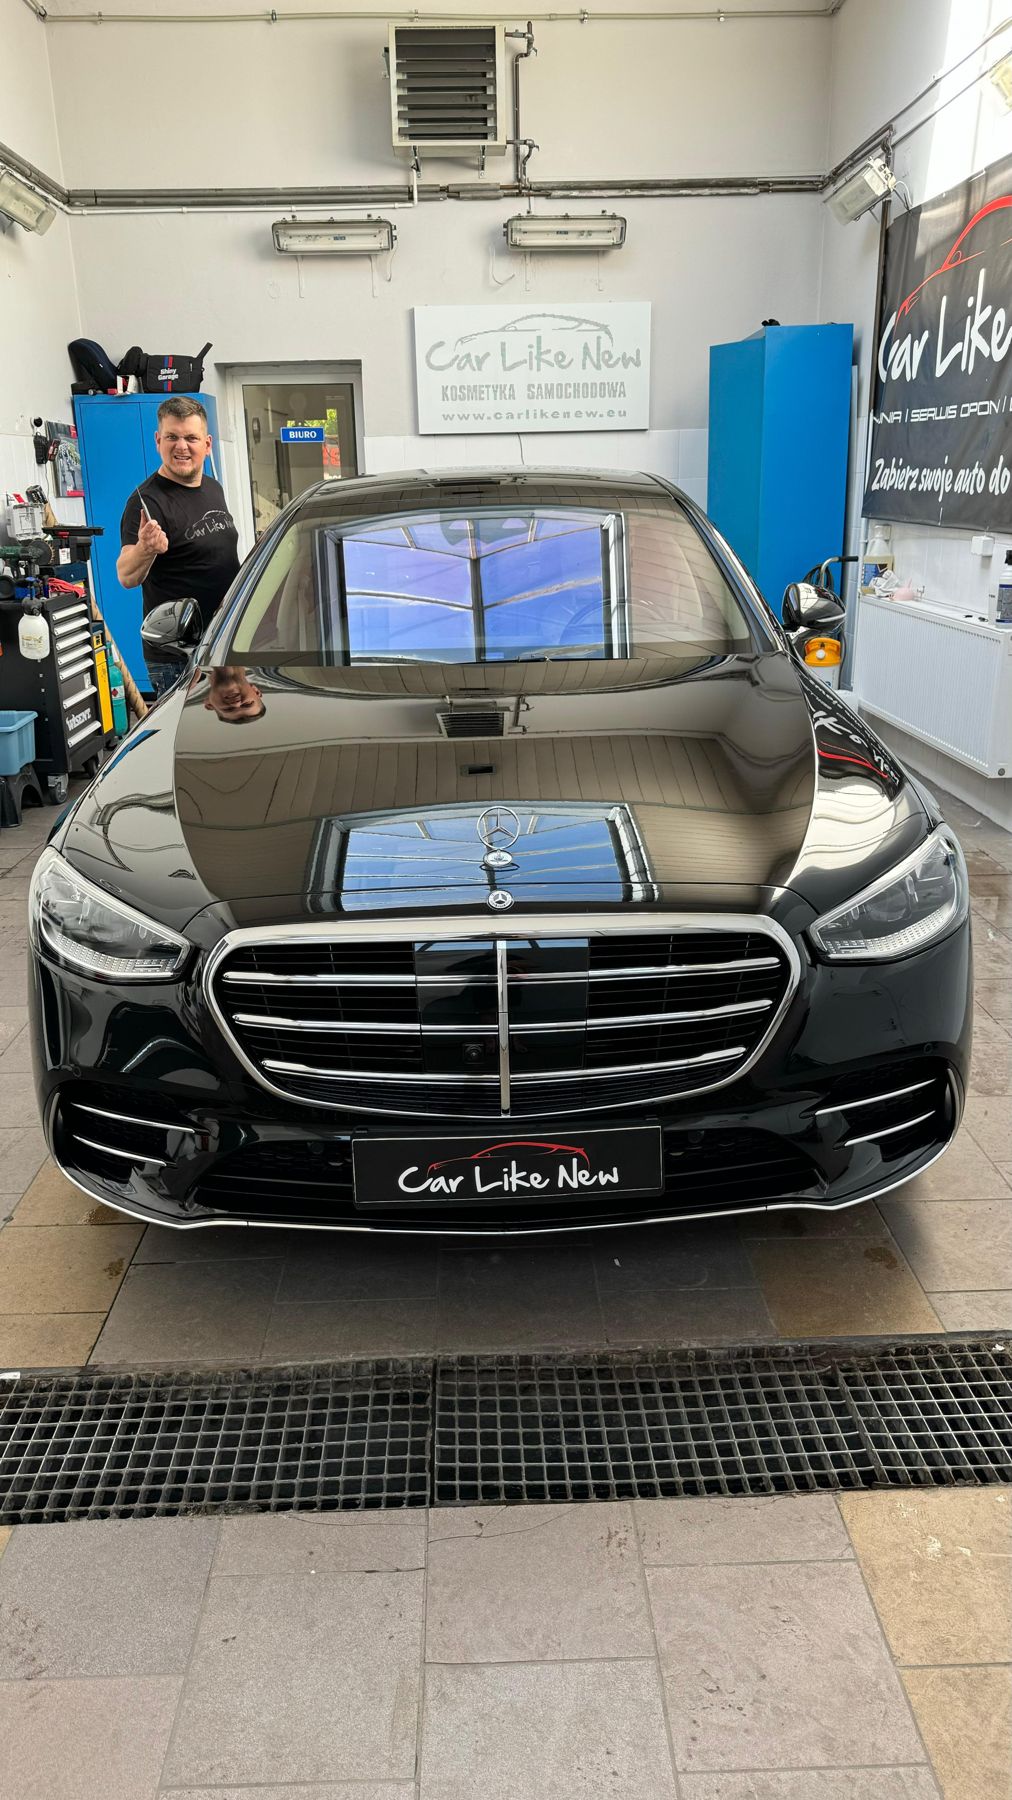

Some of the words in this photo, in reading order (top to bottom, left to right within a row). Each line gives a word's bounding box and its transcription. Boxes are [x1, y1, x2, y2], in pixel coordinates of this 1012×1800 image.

[878, 311, 929, 383] Car
[935, 268, 1012, 377] Like
[425, 340, 491, 371] Car
[500, 335, 574, 372] Like
[582, 335, 642, 371] New
[441, 383, 516, 402] KOSMETYKA
[527, 381, 627, 400] SAMOCHODOWA
[442, 408, 627, 421] www.carlikenew.eu
[910, 405, 958, 422] SERWIS
[960, 399, 1001, 418] OPON
[289, 430, 317, 439] BIURO
[871, 457, 919, 491] Zabierz
[918, 455, 953, 502] swoje
[953, 460, 986, 495] auto
[989, 454, 1011, 496] do
[184, 527, 206, 540] Car
[398, 1166, 465, 1194] Car
[474, 1160, 550, 1193] Like
[557, 1157, 620, 1189] New
